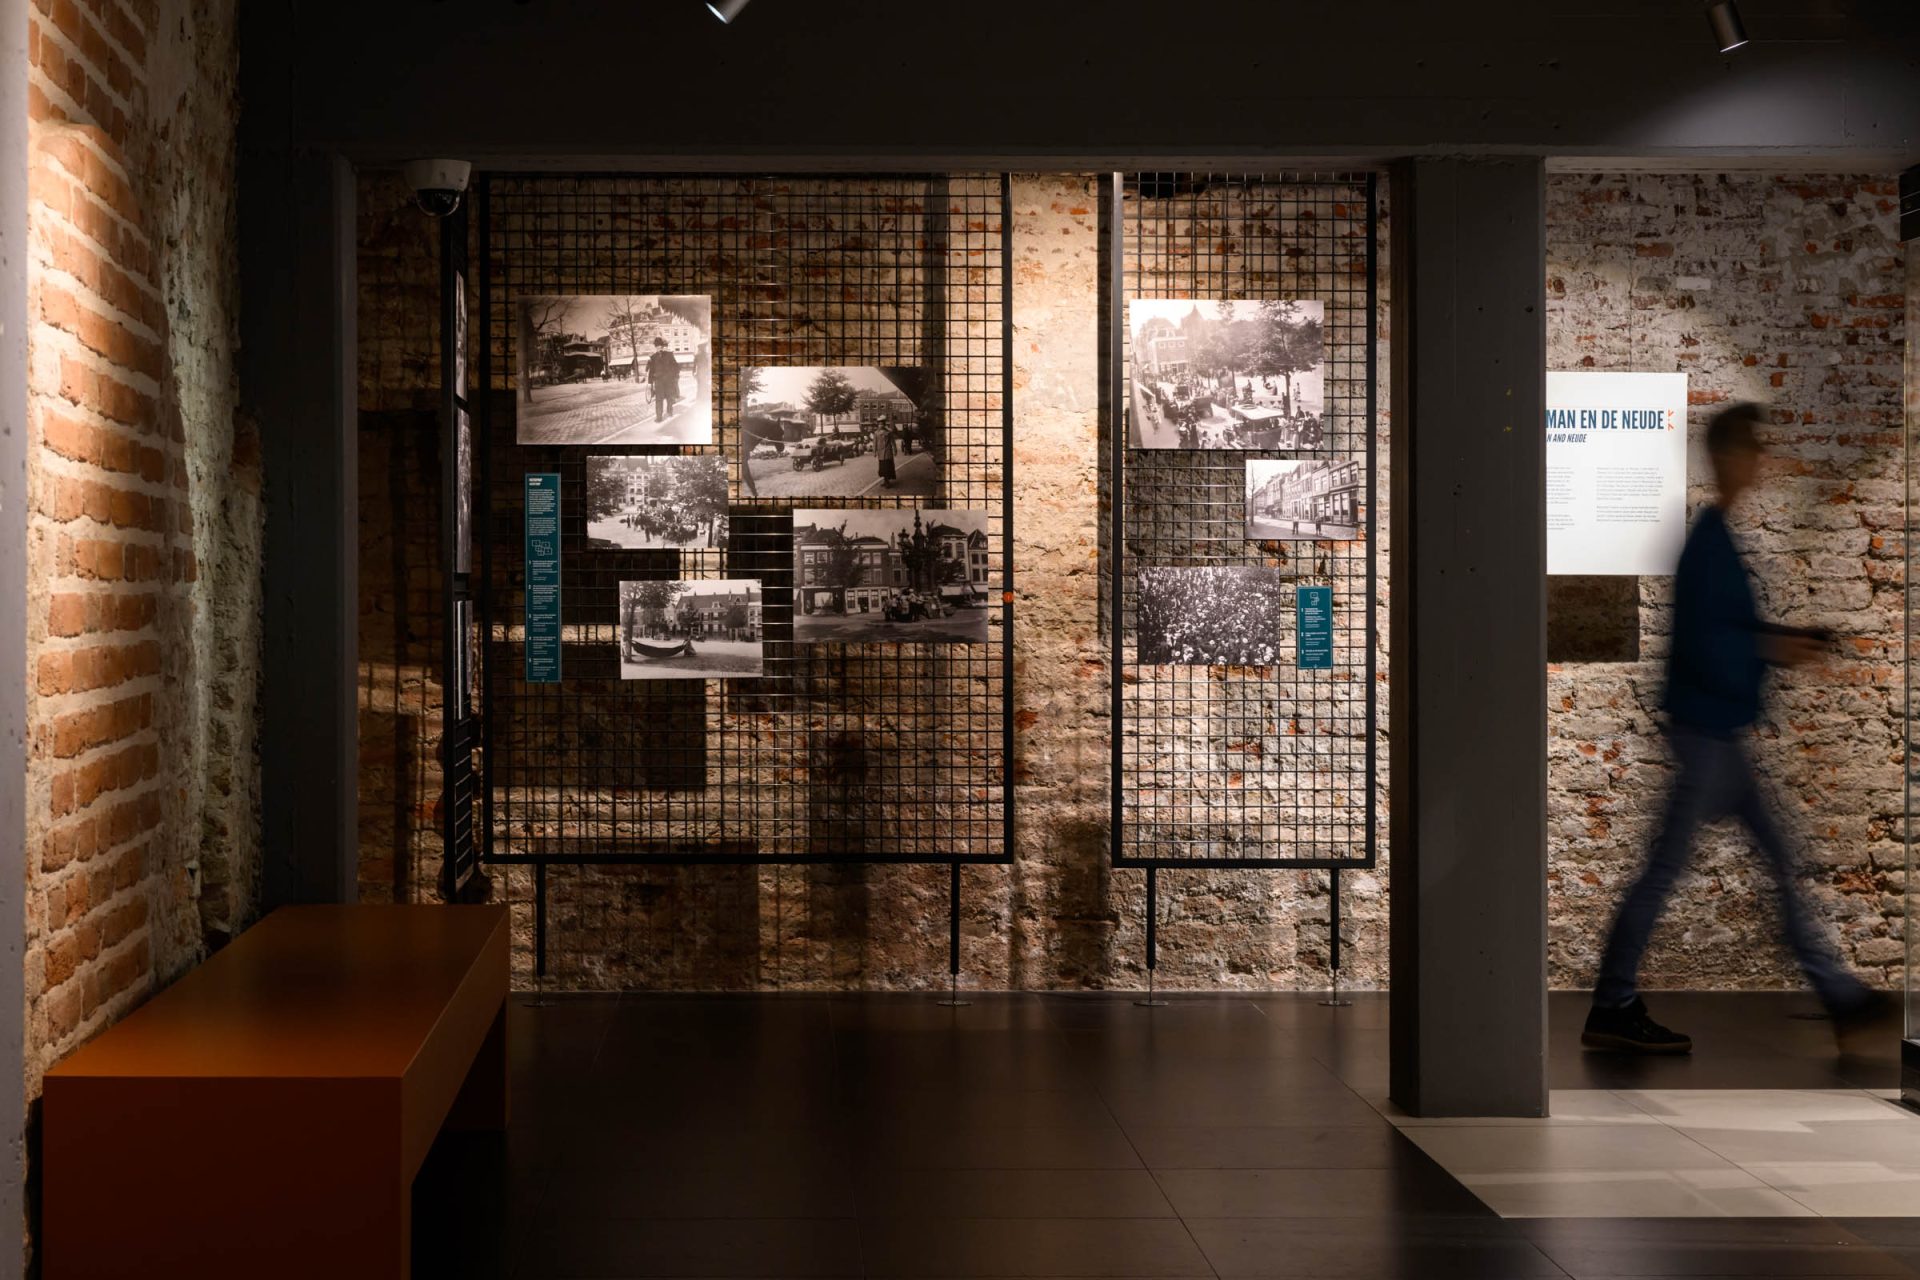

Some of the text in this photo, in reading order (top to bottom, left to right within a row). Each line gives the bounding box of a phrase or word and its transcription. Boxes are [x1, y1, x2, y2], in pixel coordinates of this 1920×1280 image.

[1546, 409, 1664, 430] MAN EN DE NEUDE
[1553, 433, 1566, 443] AND
[1567, 433, 1587, 443] NEUDE
